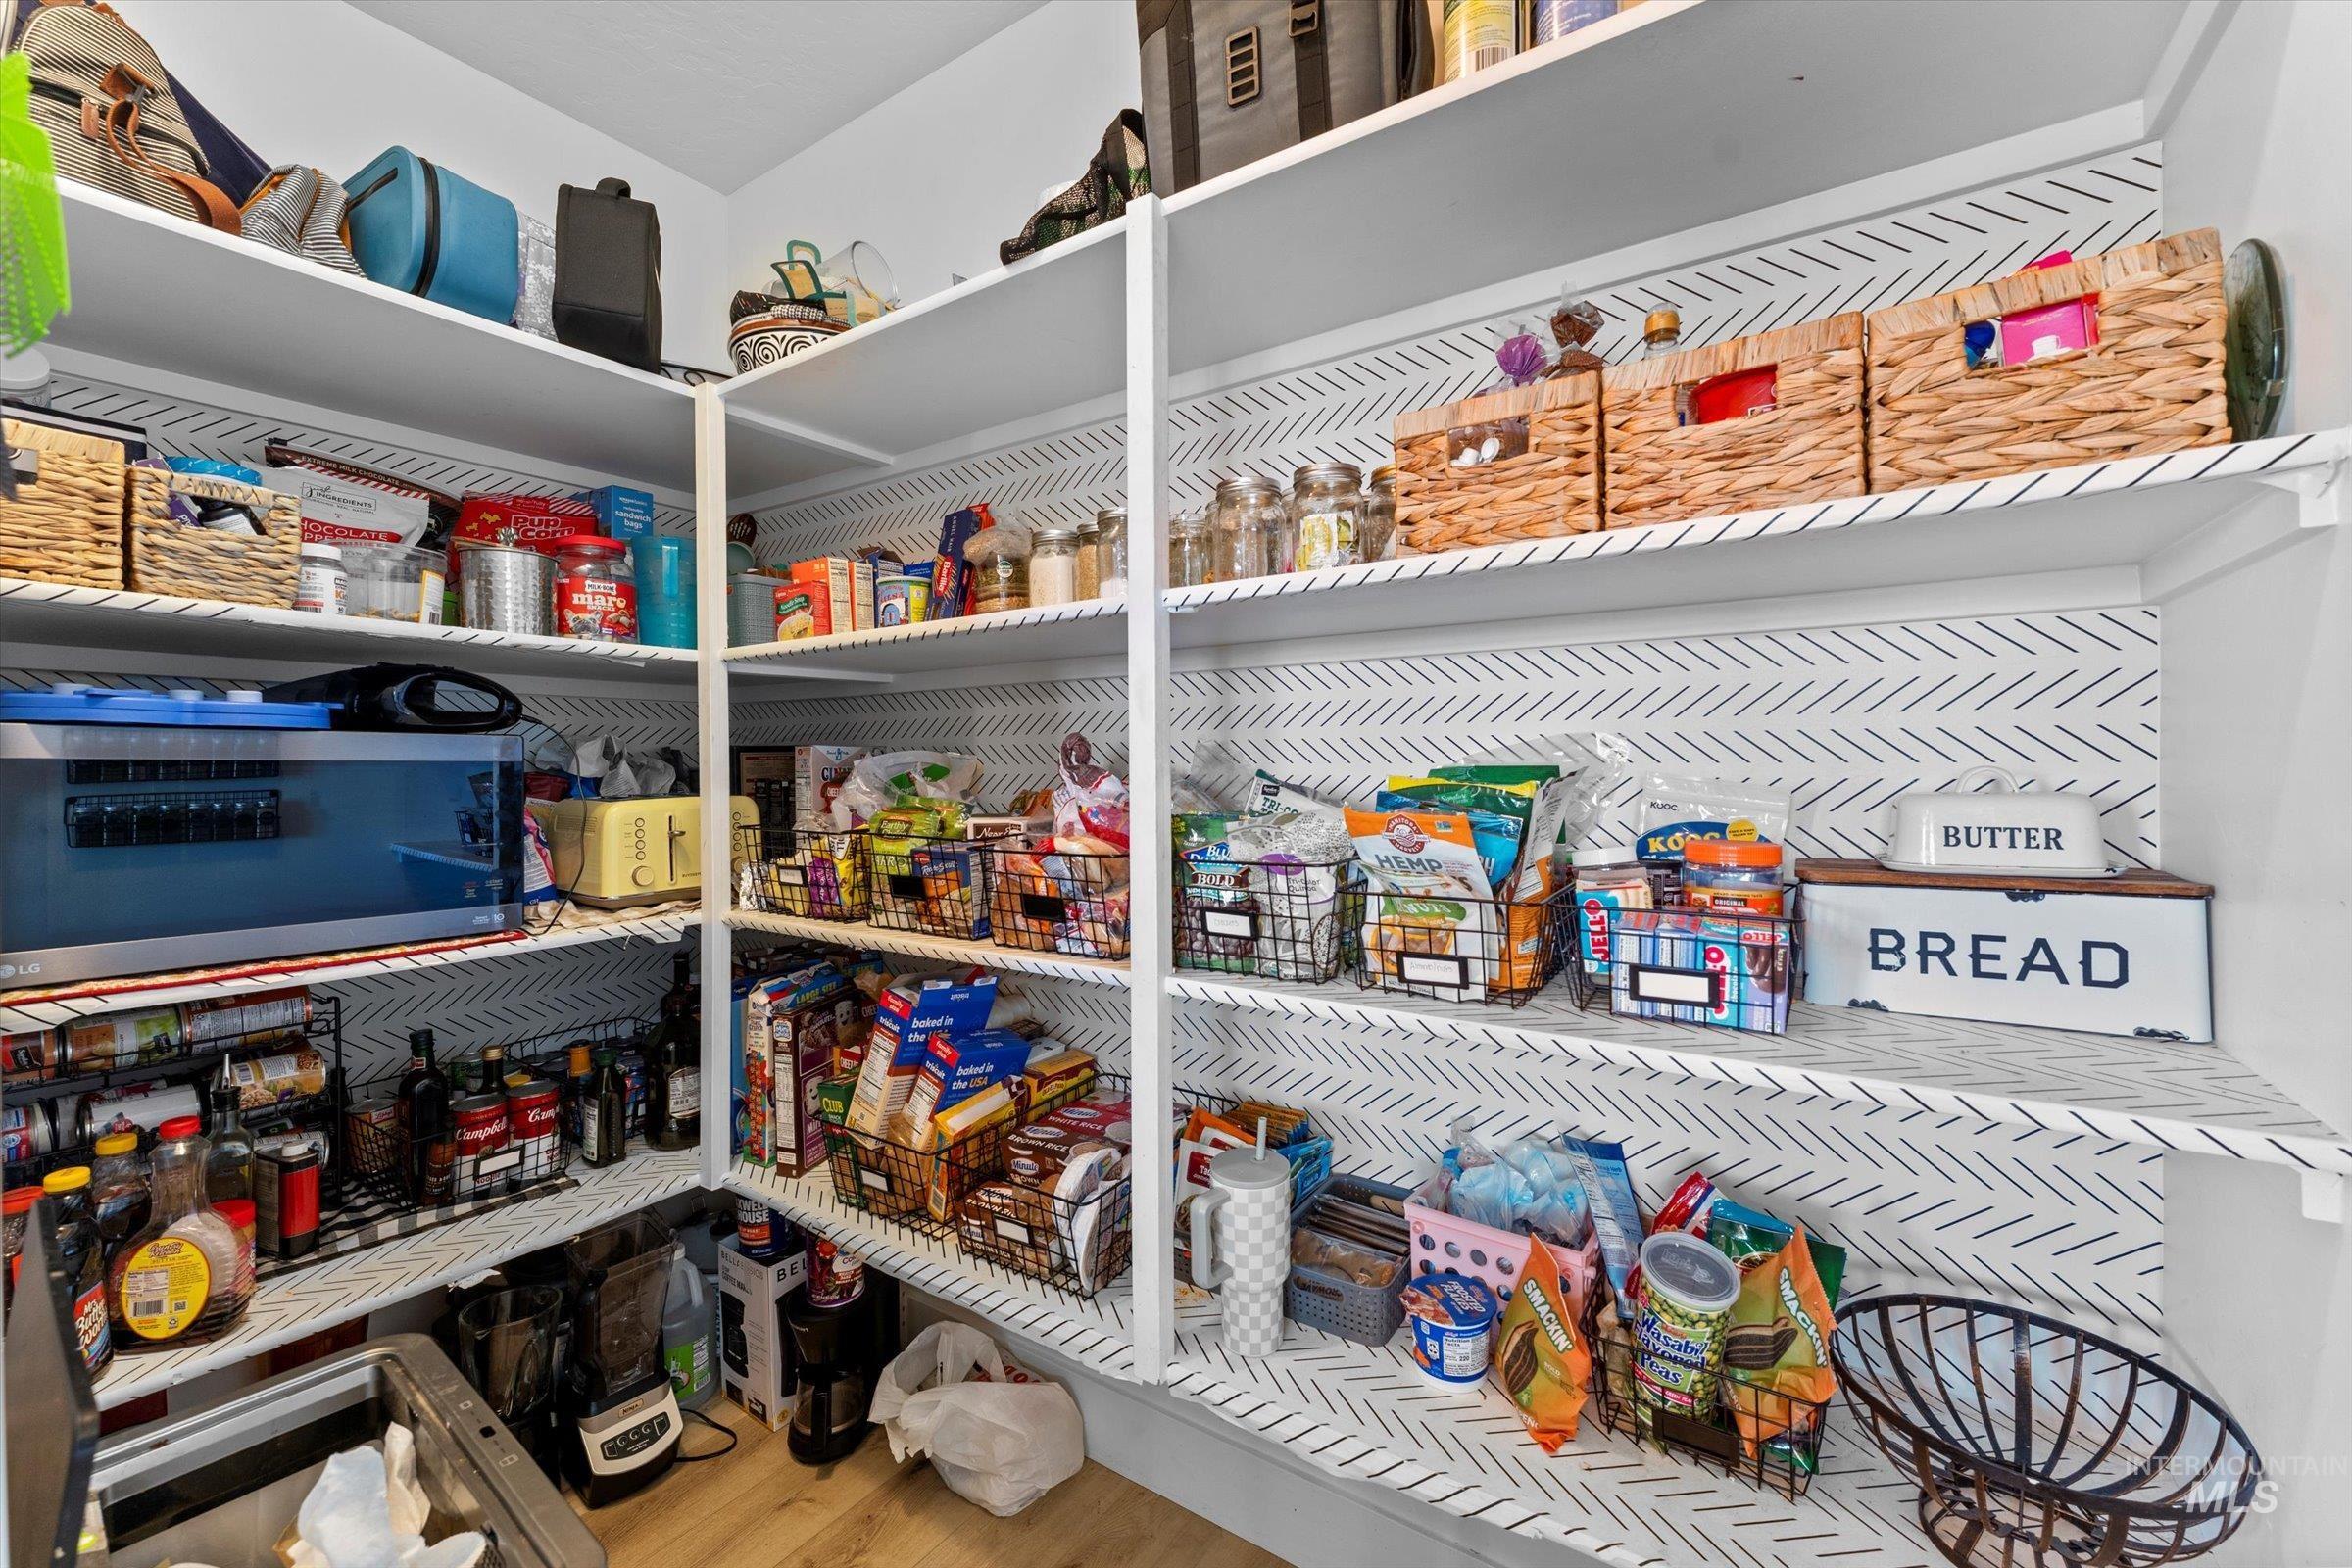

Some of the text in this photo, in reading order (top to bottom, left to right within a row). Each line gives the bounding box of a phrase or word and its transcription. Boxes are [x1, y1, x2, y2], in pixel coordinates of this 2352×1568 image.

[301, 456, 400, 487] EXTREME MILK CHOCOLATE
[316, 490, 372, 509] INGREDIENTS
[511, 514, 561, 531] Pup
[614, 510, 652, 523] sandwich
[623, 518, 644, 529] bags
[301, 520, 388, 540] HOCOLATE
[519, 527, 575, 540] Corn
[938, 561, 952, 592] Barilla
[1650, 801, 1678, 811] KOOC
[1943, 826, 2064, 850] BUTTER
[1374, 854, 1443, 872] HEMP
[1198, 874, 1235, 886] BOLD
[1714, 899, 1745, 907] ORIGINAL
[1868, 928, 2129, 989] BREAD
[18, 963, 41, 974] LG
[796, 989, 820, 1004] LARGE
[887, 994, 905, 1008] family
[888, 1003, 901, 1013] size
[879, 1016, 901, 1033] triscuit
[911, 1015, 954, 1029] baked in
[907, 1032, 927, 1043] the
[936, 1040, 953, 1056] family
[936, 1049, 948, 1060] size
[925, 1060, 946, 1080] triscuit
[956, 1062, 995, 1076] baked in
[952, 1076, 989, 1090] the USA
[823, 1097, 845, 1113] CLUB
[1047, 1115, 1104, 1131] WHITE RICE
[1008, 1134, 1069, 1152] BROWN RICE
[1011, 1158, 1039, 1172] Minute
[1523, 1279, 1574, 1352] SMACKIN'
[1780, 1267, 1828, 1366] SMACKIN'
[1641, 1352, 1683, 1385] Peas
